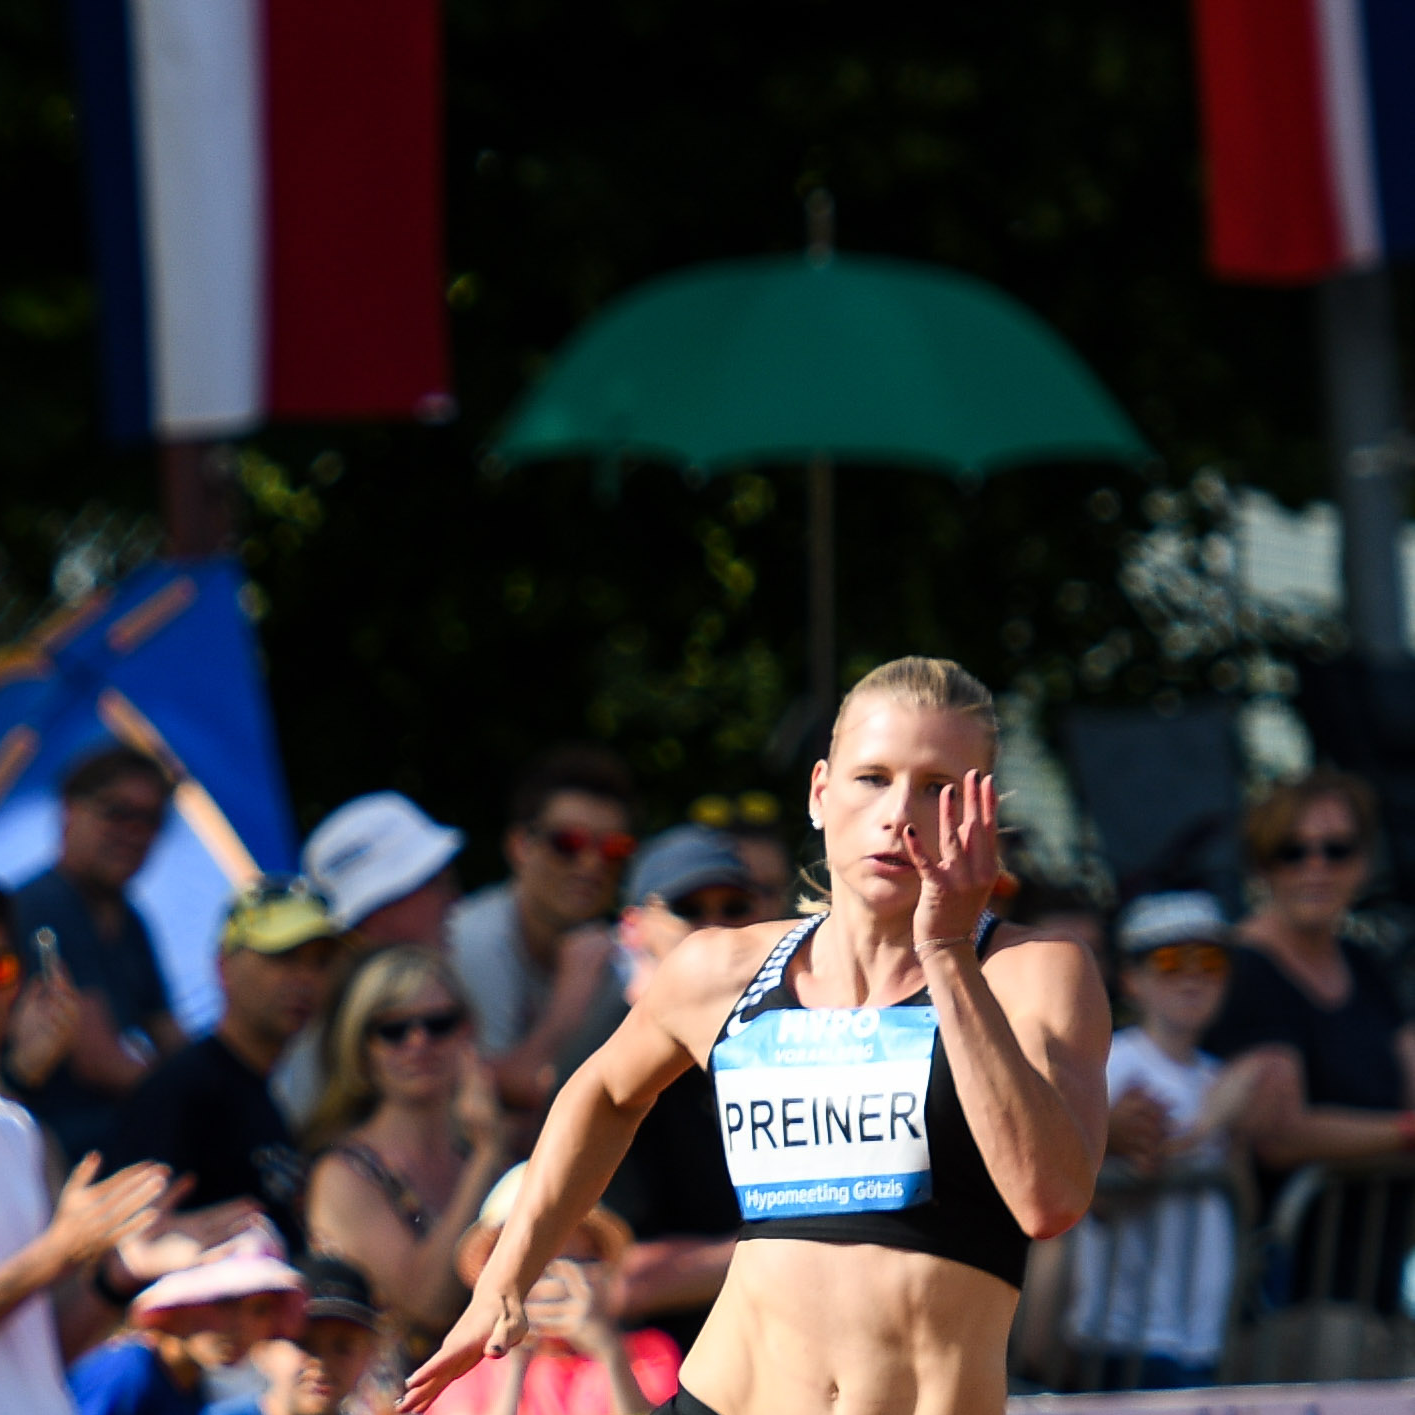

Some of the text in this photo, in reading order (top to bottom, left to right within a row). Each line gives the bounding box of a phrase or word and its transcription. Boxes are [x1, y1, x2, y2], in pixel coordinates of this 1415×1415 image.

[778, 1009, 881, 1043] HYPO
[725, 1092, 922, 1154] PREINER
[745, 1178, 904, 1210] Hypomeeting Götzis
